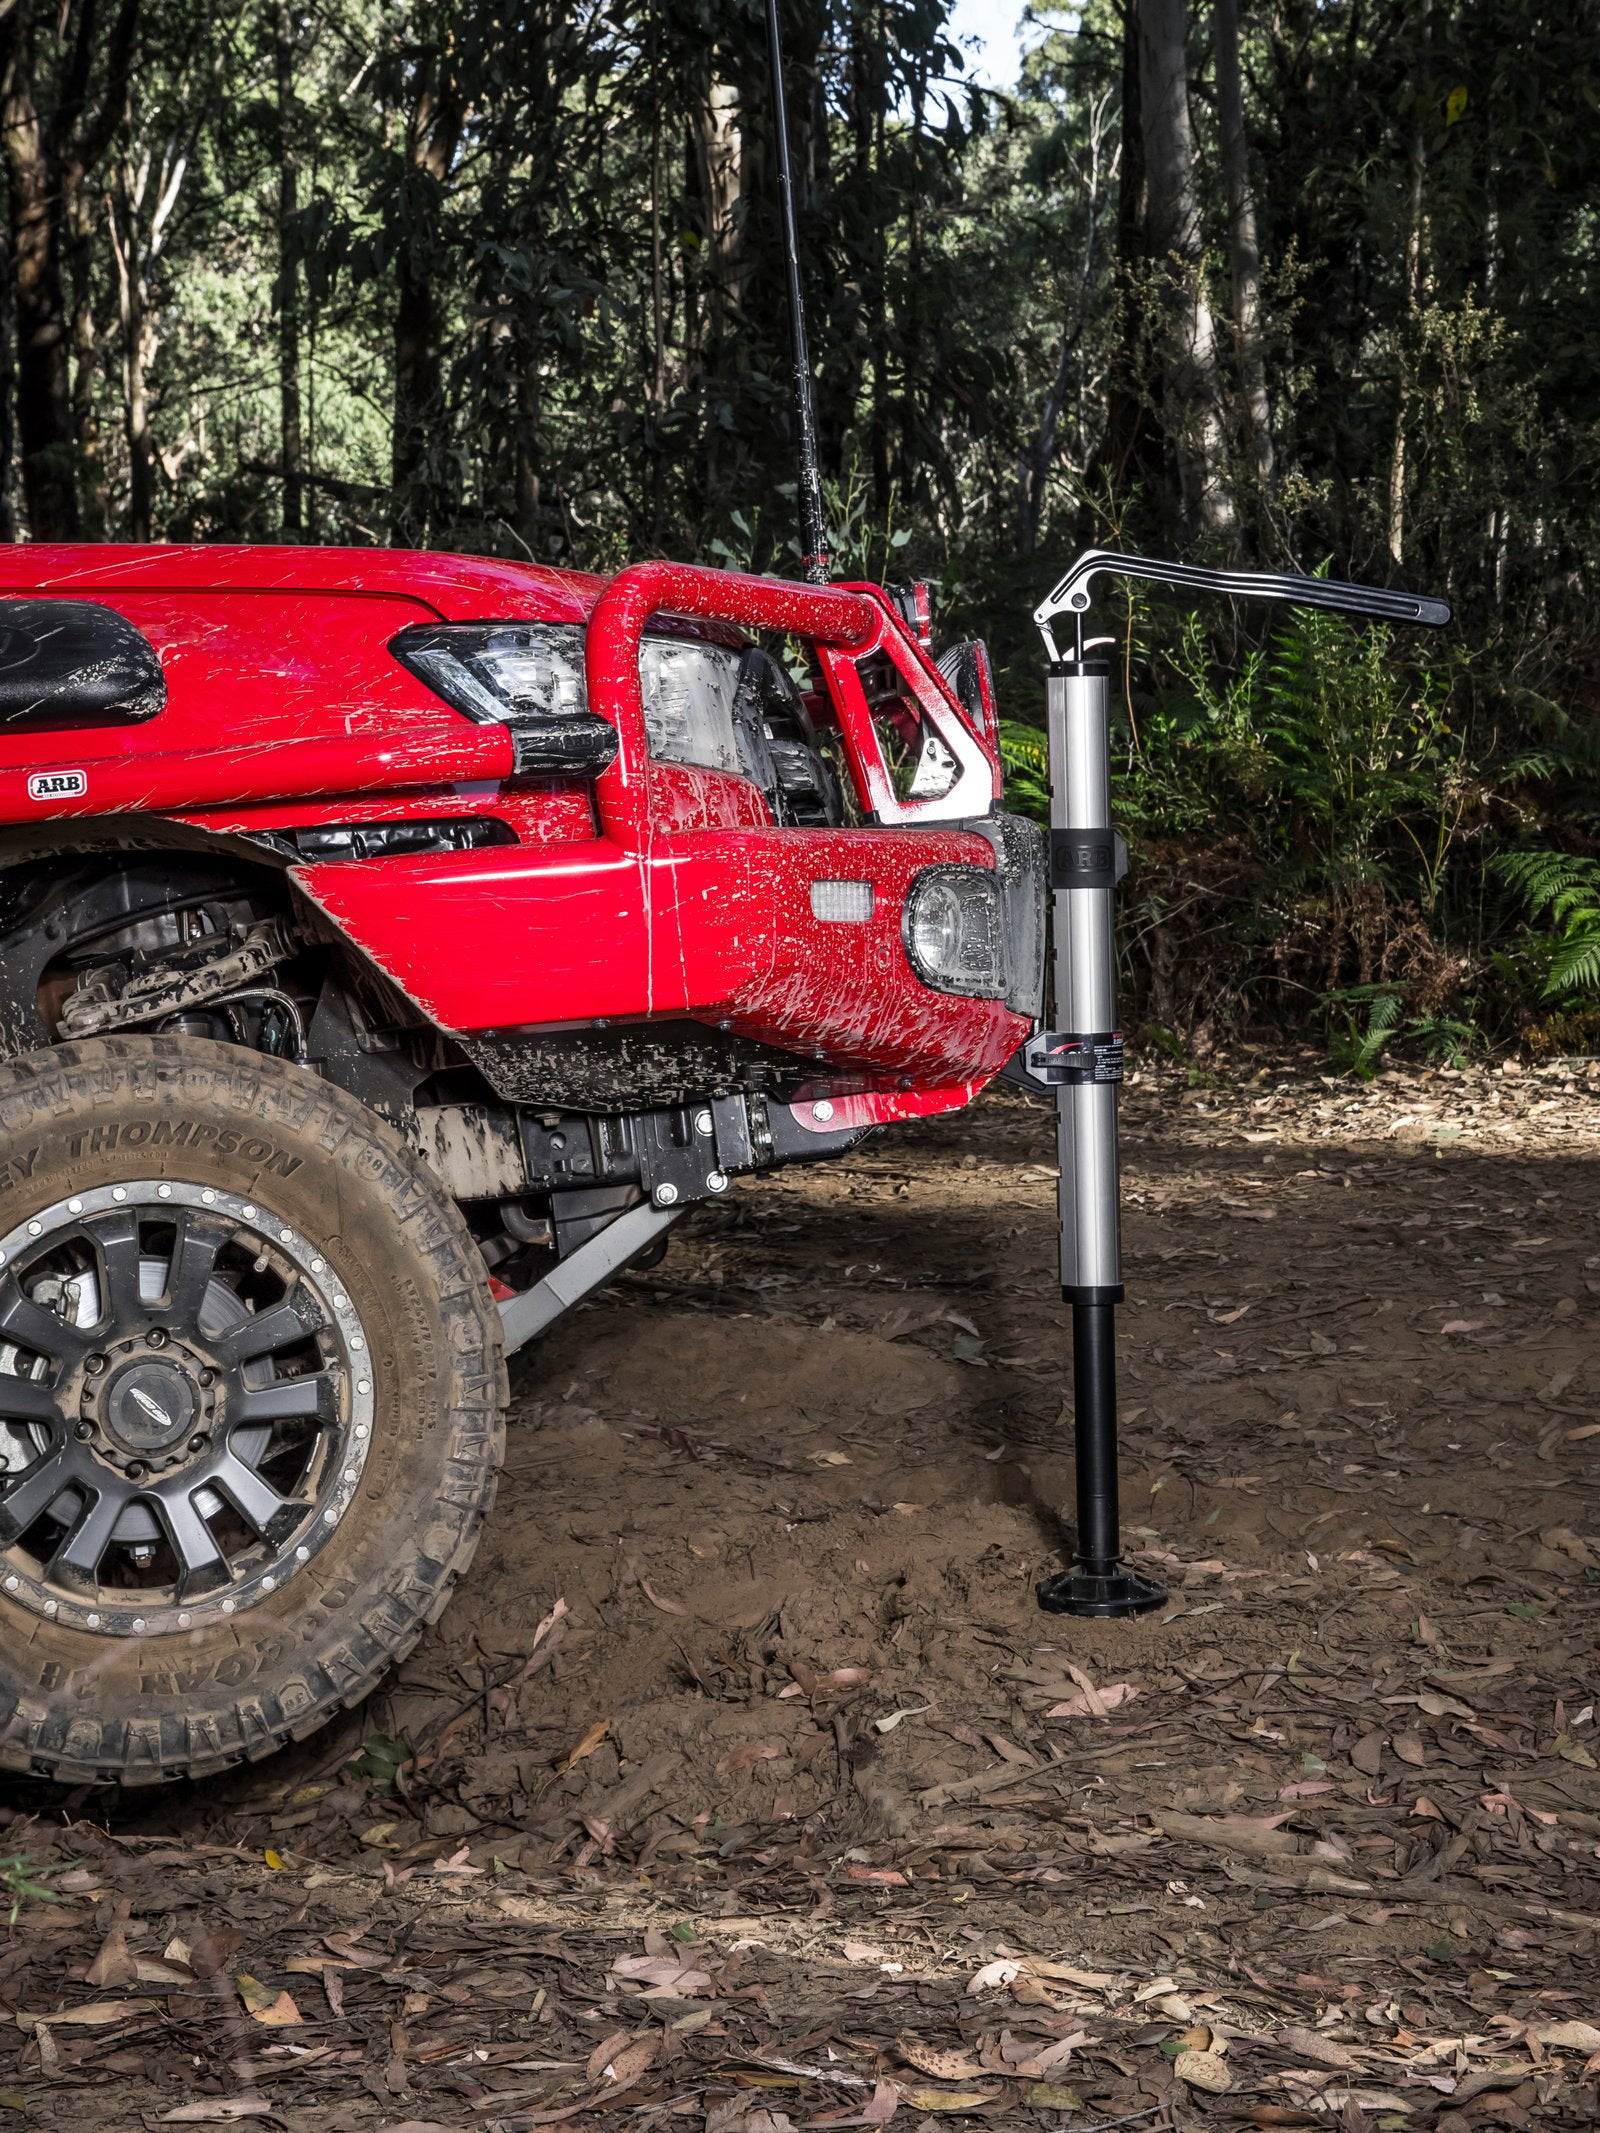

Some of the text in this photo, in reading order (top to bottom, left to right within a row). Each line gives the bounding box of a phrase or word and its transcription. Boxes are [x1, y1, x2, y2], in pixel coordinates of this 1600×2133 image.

[37, 776, 80, 794] ARB
[1061, 850, 1108, 868] ARB
[65, 1120, 304, 1179] THOMPSON
